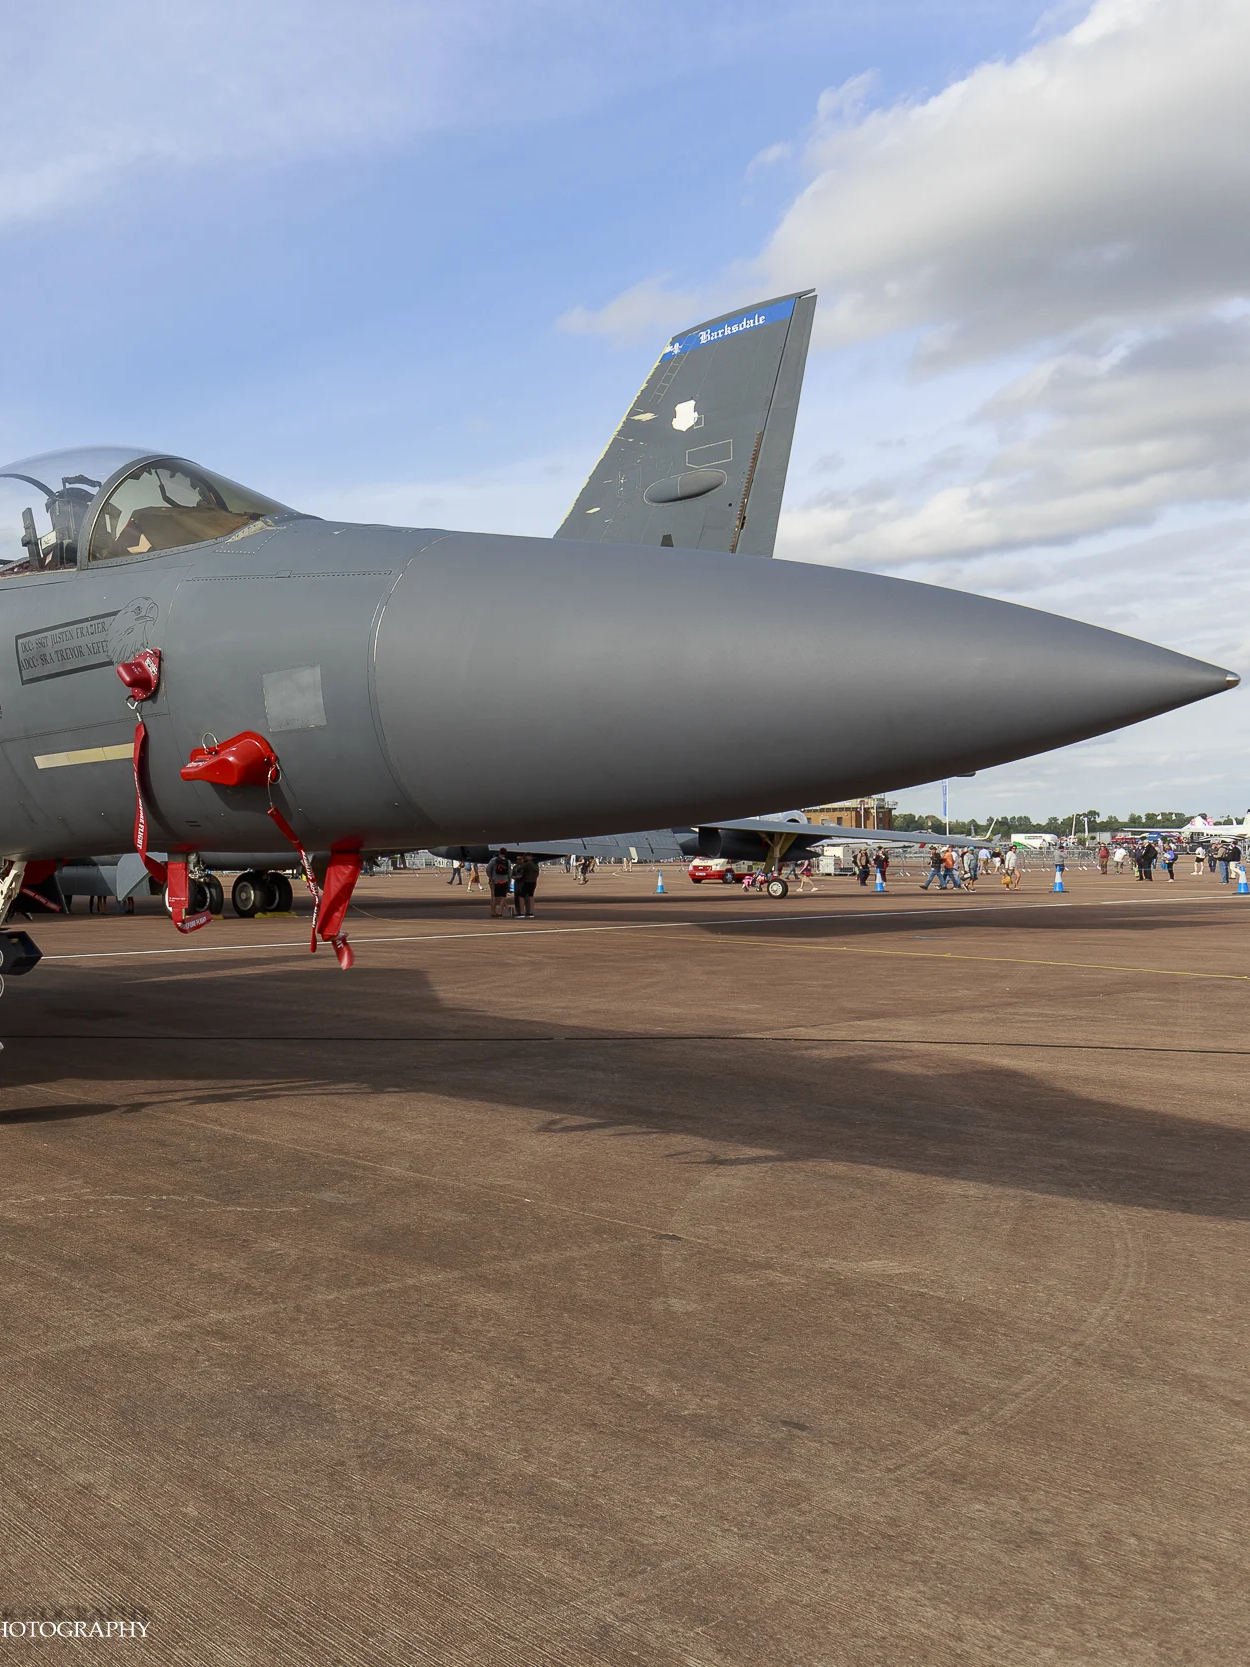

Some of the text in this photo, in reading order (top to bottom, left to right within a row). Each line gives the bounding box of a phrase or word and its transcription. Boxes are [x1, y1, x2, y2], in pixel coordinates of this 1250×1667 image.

[699, 314, 765, 344] Barksdale
[75, 621, 107, 639] FRAZIER
[40, 651, 55, 666] SRA
[54, 643, 86, 663] TREVOR
[137, 822, 146, 849] FLIGHT
